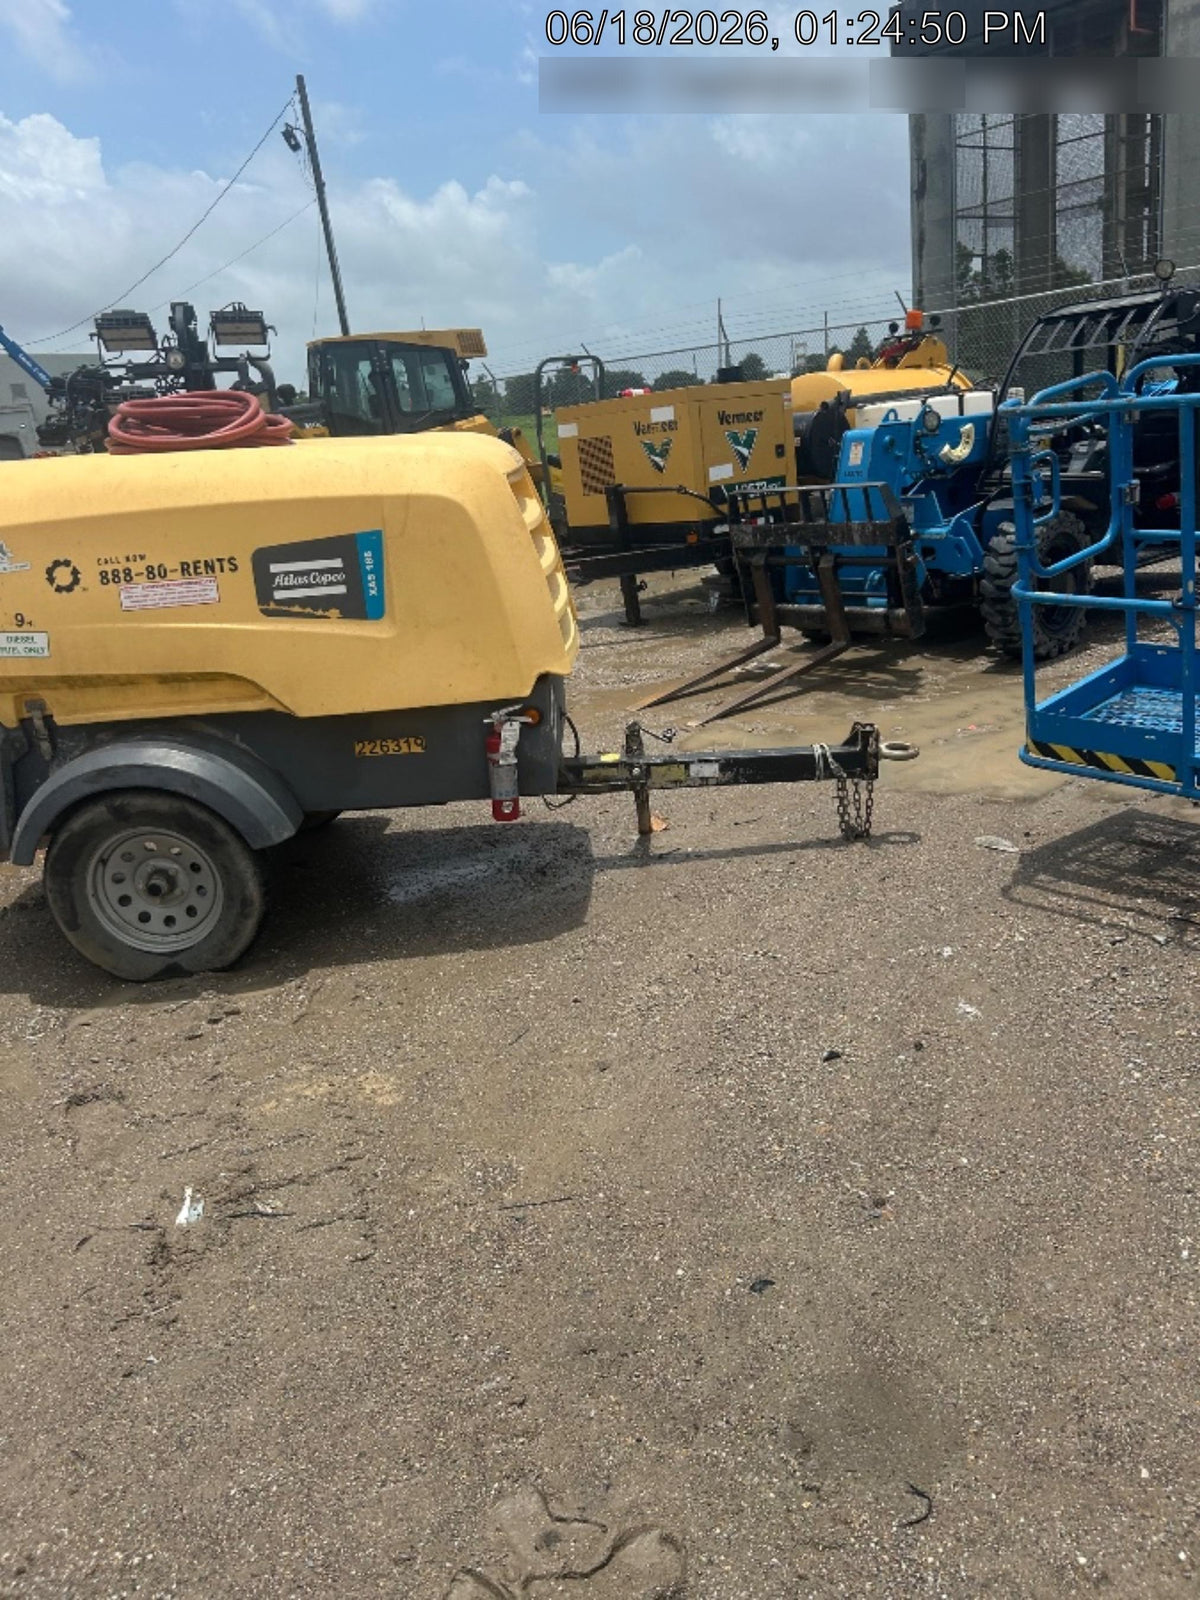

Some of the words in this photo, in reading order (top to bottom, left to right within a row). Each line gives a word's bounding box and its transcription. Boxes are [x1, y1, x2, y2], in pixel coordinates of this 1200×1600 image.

[717, 409, 764, 426] Vermeer
[97, 557, 121, 566] CALL
[124, 553, 146, 563] NOW
[364, 550, 374, 571] 185
[99, 556, 239, 586] 888-80-RENTS
[357, 737, 427, 755] 226319
